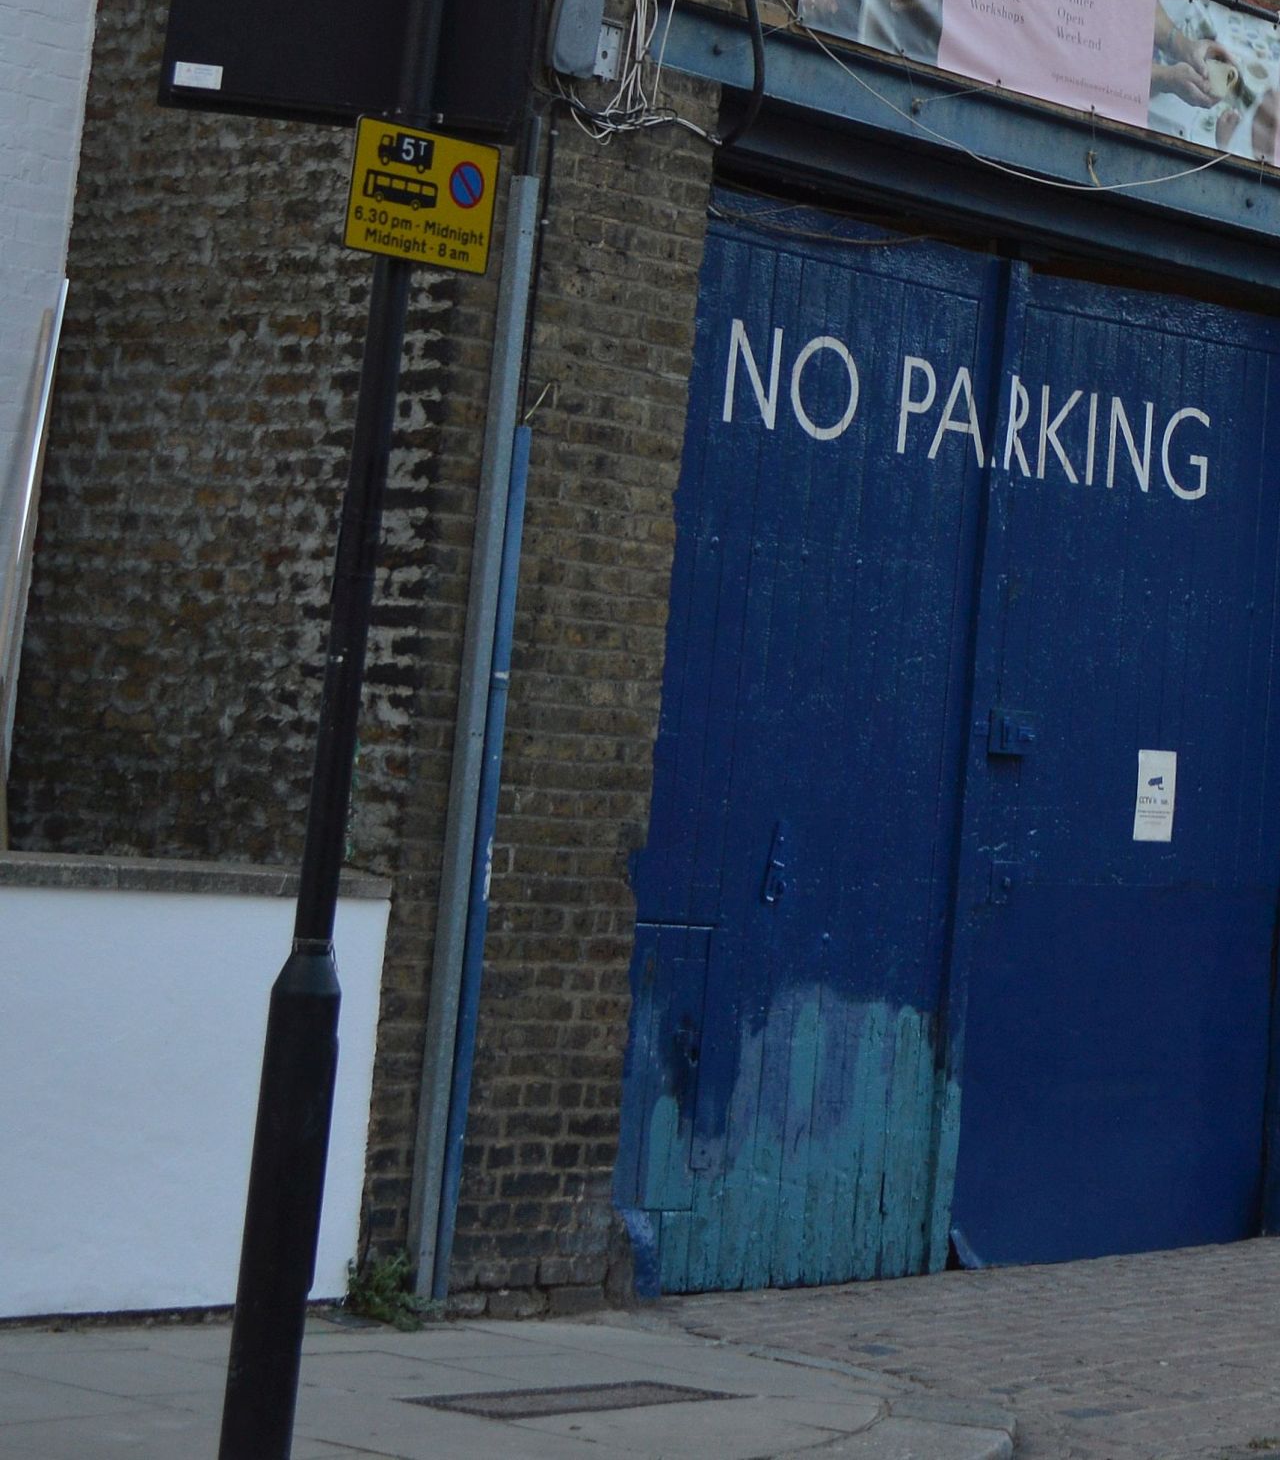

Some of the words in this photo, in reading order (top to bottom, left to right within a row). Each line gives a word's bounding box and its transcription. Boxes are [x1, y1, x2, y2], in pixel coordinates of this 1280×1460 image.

[1056, 7, 1085, 26] Open
[1056, 26, 1102, 51] Weekend
[354, 206, 388, 225] 6.30
[391, 217, 412, 230] pm
[424, 222, 484, 246] Midnight
[365, 228, 428, 253] Midnight
[438, 243, 447, 258] 8
[449, 250, 470, 262] am
[722, 318, 860, 441] NO
[896, 355, 1212, 501] PARKING
